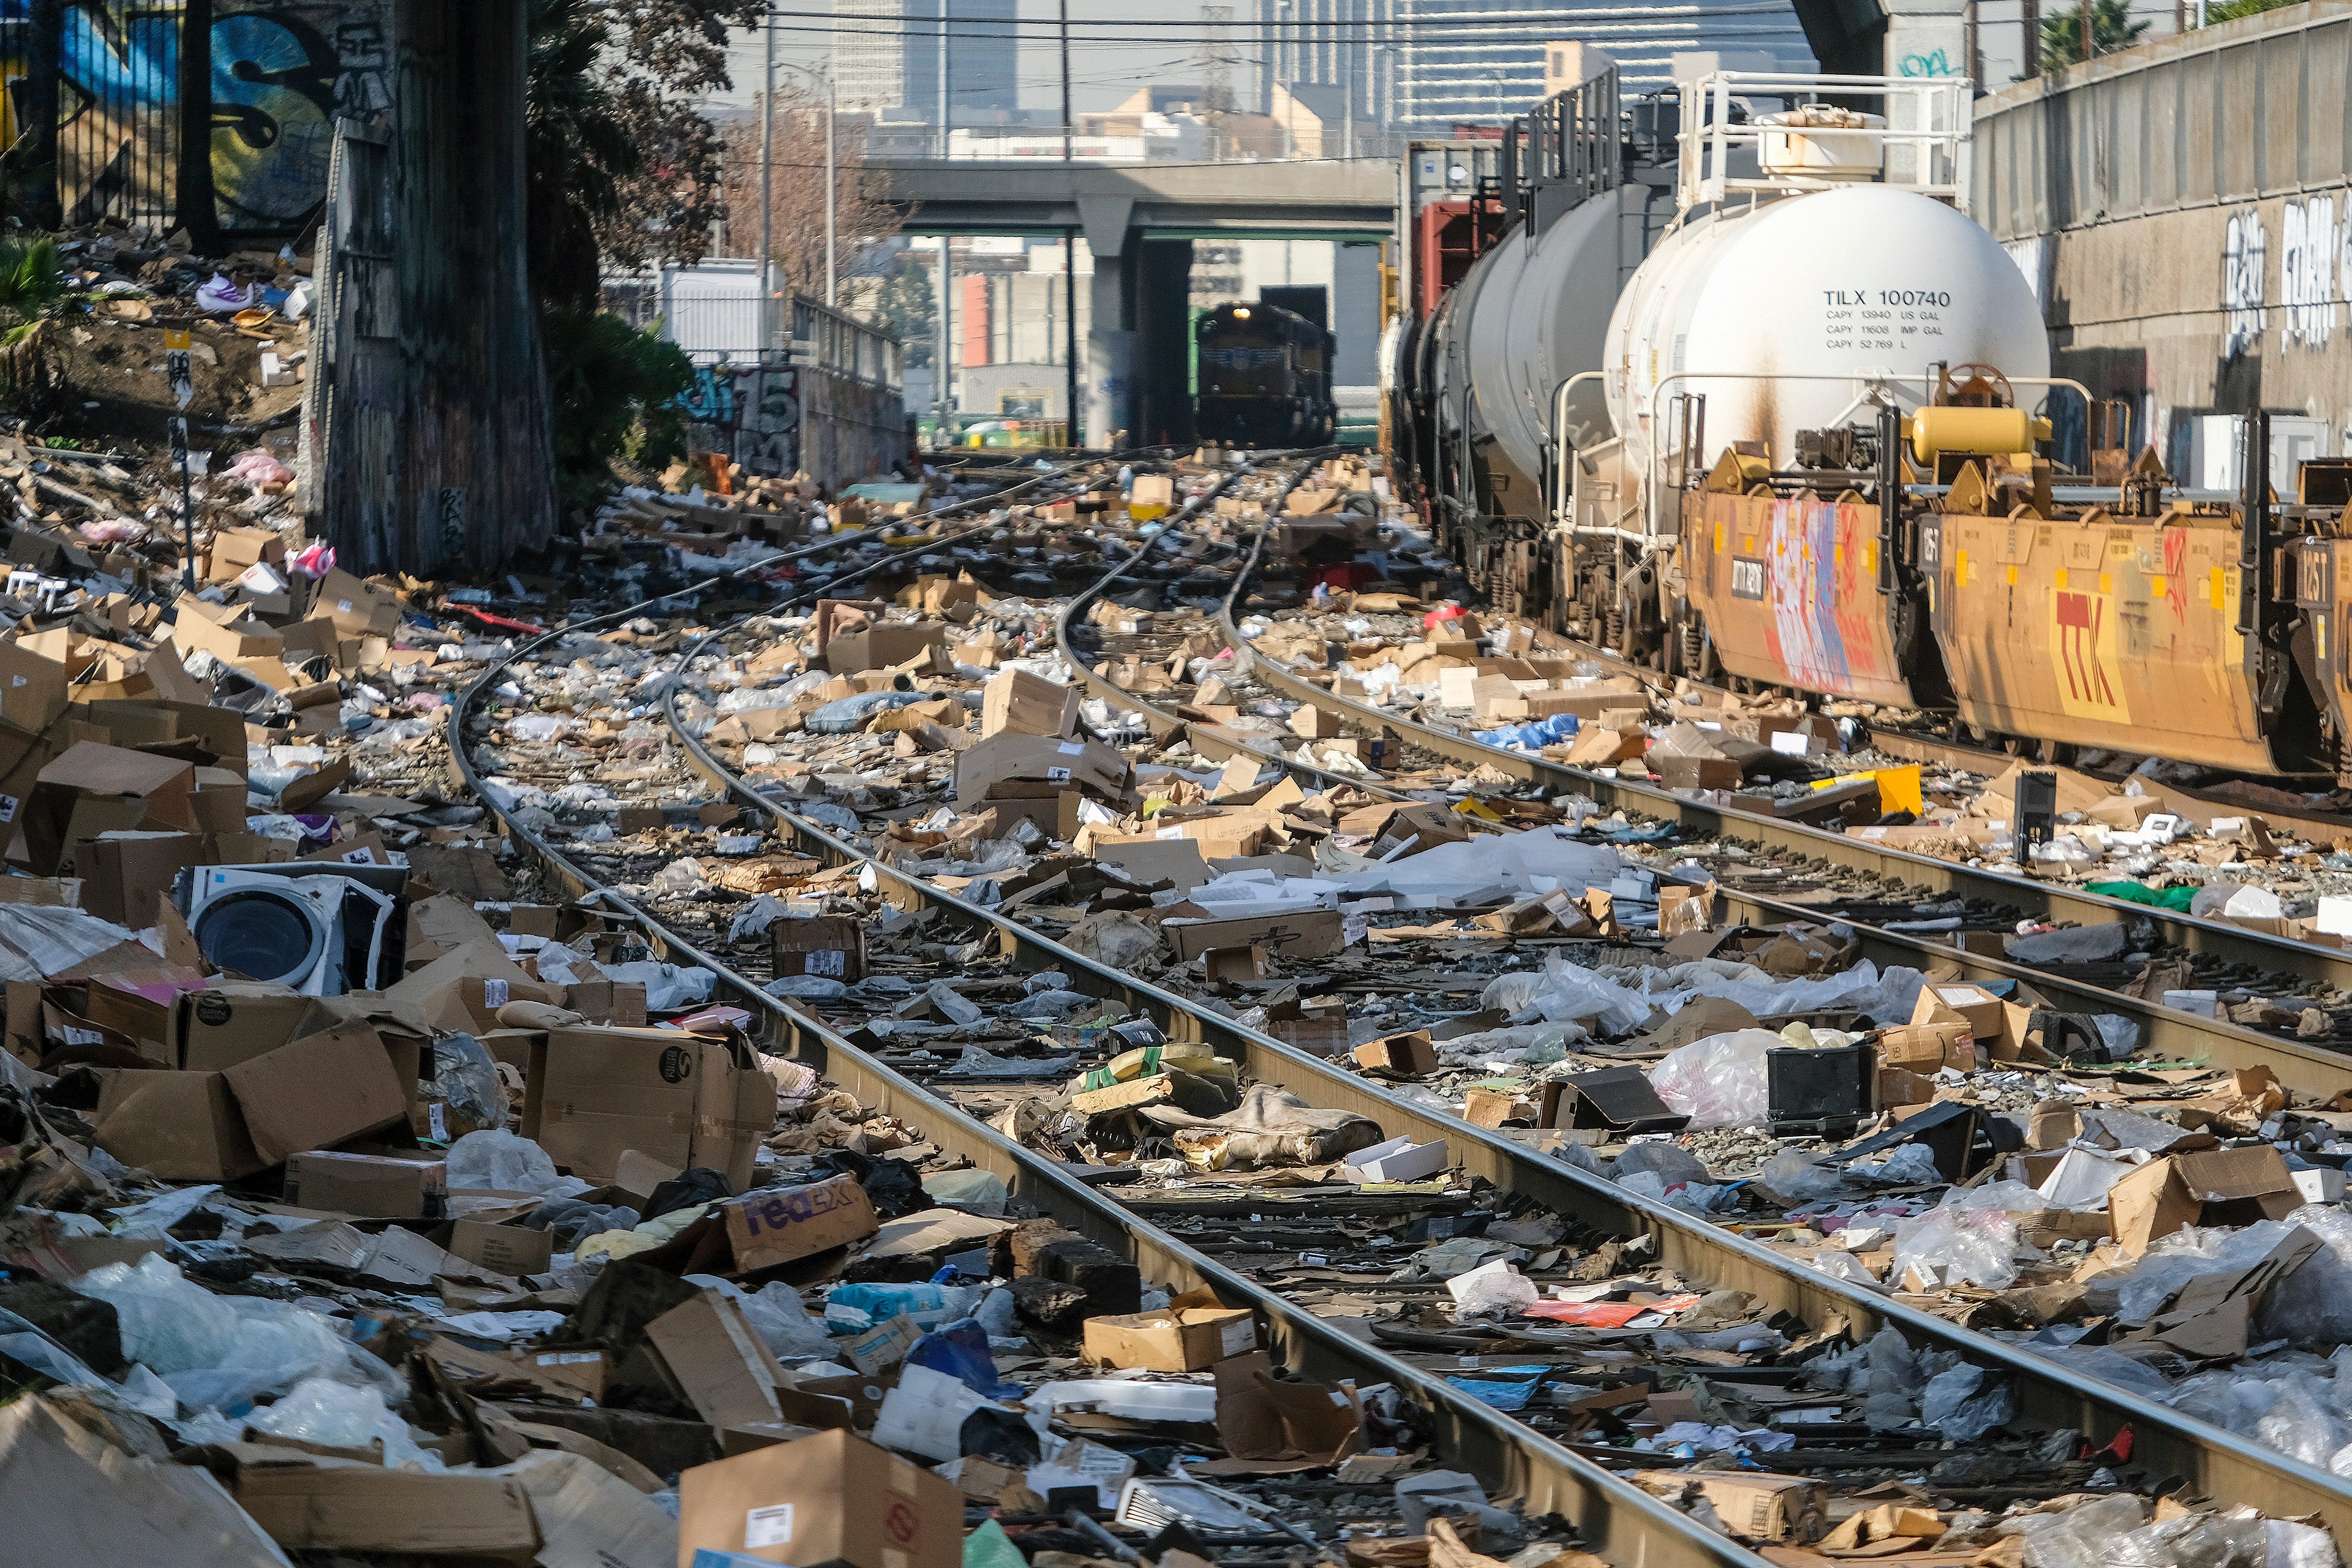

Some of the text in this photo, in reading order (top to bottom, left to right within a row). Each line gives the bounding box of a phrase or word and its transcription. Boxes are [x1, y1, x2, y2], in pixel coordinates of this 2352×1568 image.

[1823, 290, 1951, 307] TILX 100740
[1826, 310, 1852, 320] CAPY
[1900, 311, 1915, 320] US
[1920, 311, 1940, 321] GAL
[1826, 325, 1852, 334] CAPY
[1900, 325, 1918, 334] IMP
[1922, 326, 1943, 336] GAL
[1826, 339, 1853, 349] CAPY
